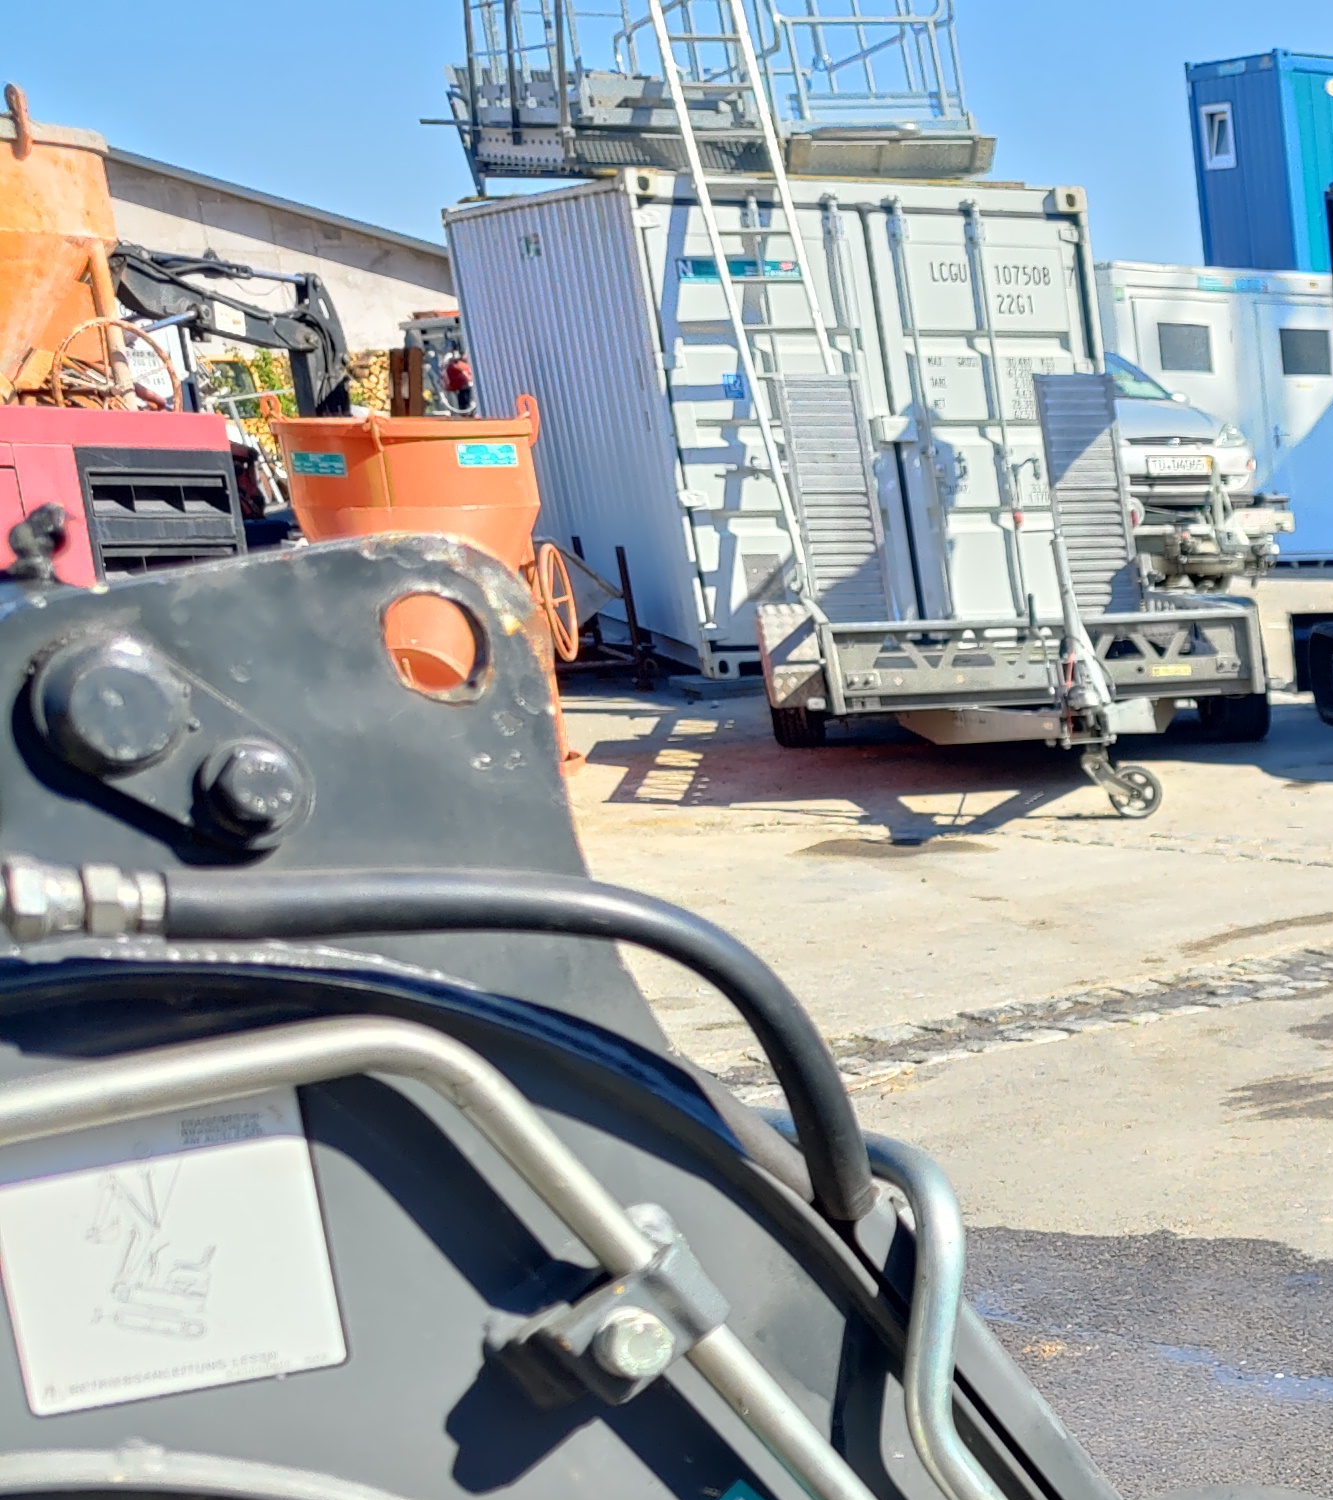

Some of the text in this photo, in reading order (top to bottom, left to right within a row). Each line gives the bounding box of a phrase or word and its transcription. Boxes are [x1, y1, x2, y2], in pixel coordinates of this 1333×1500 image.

[929, 261, 1075, 287] LCGU 107508 7
[997, 294, 1034, 315] 22G1
